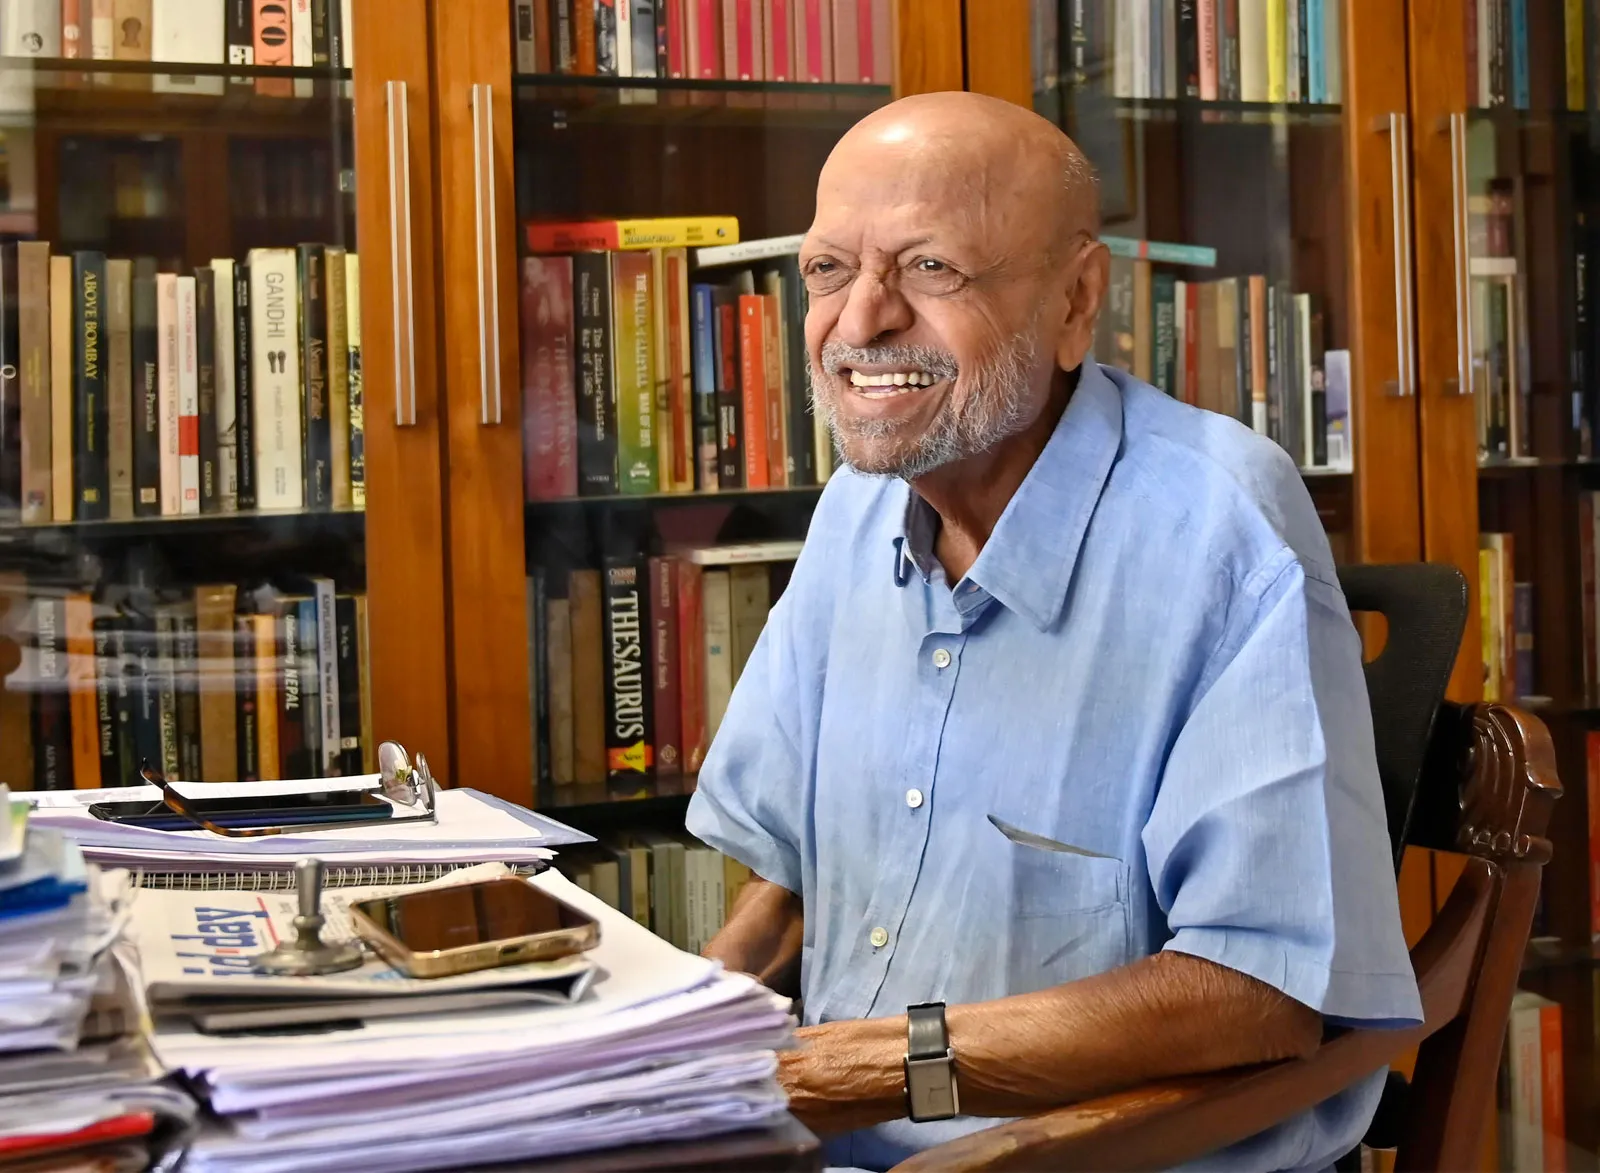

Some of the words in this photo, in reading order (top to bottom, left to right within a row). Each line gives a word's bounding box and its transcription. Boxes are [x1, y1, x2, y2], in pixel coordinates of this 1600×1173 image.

[83, 270, 98, 317] ABOVE
[635, 273, 647, 292] THE
[265, 272, 286, 338] GANDHI
[85, 320, 99, 380] BOMBAY
[593, 328, 603, 348] The
[582, 352, 592, 365] of
[638, 392, 650, 414] WAR
[639, 414, 651, 428] OF
[610, 590, 645, 739] THESAURUS
[284, 668, 299, 711] NEPAL
[101, 724, 114, 757] Mind
